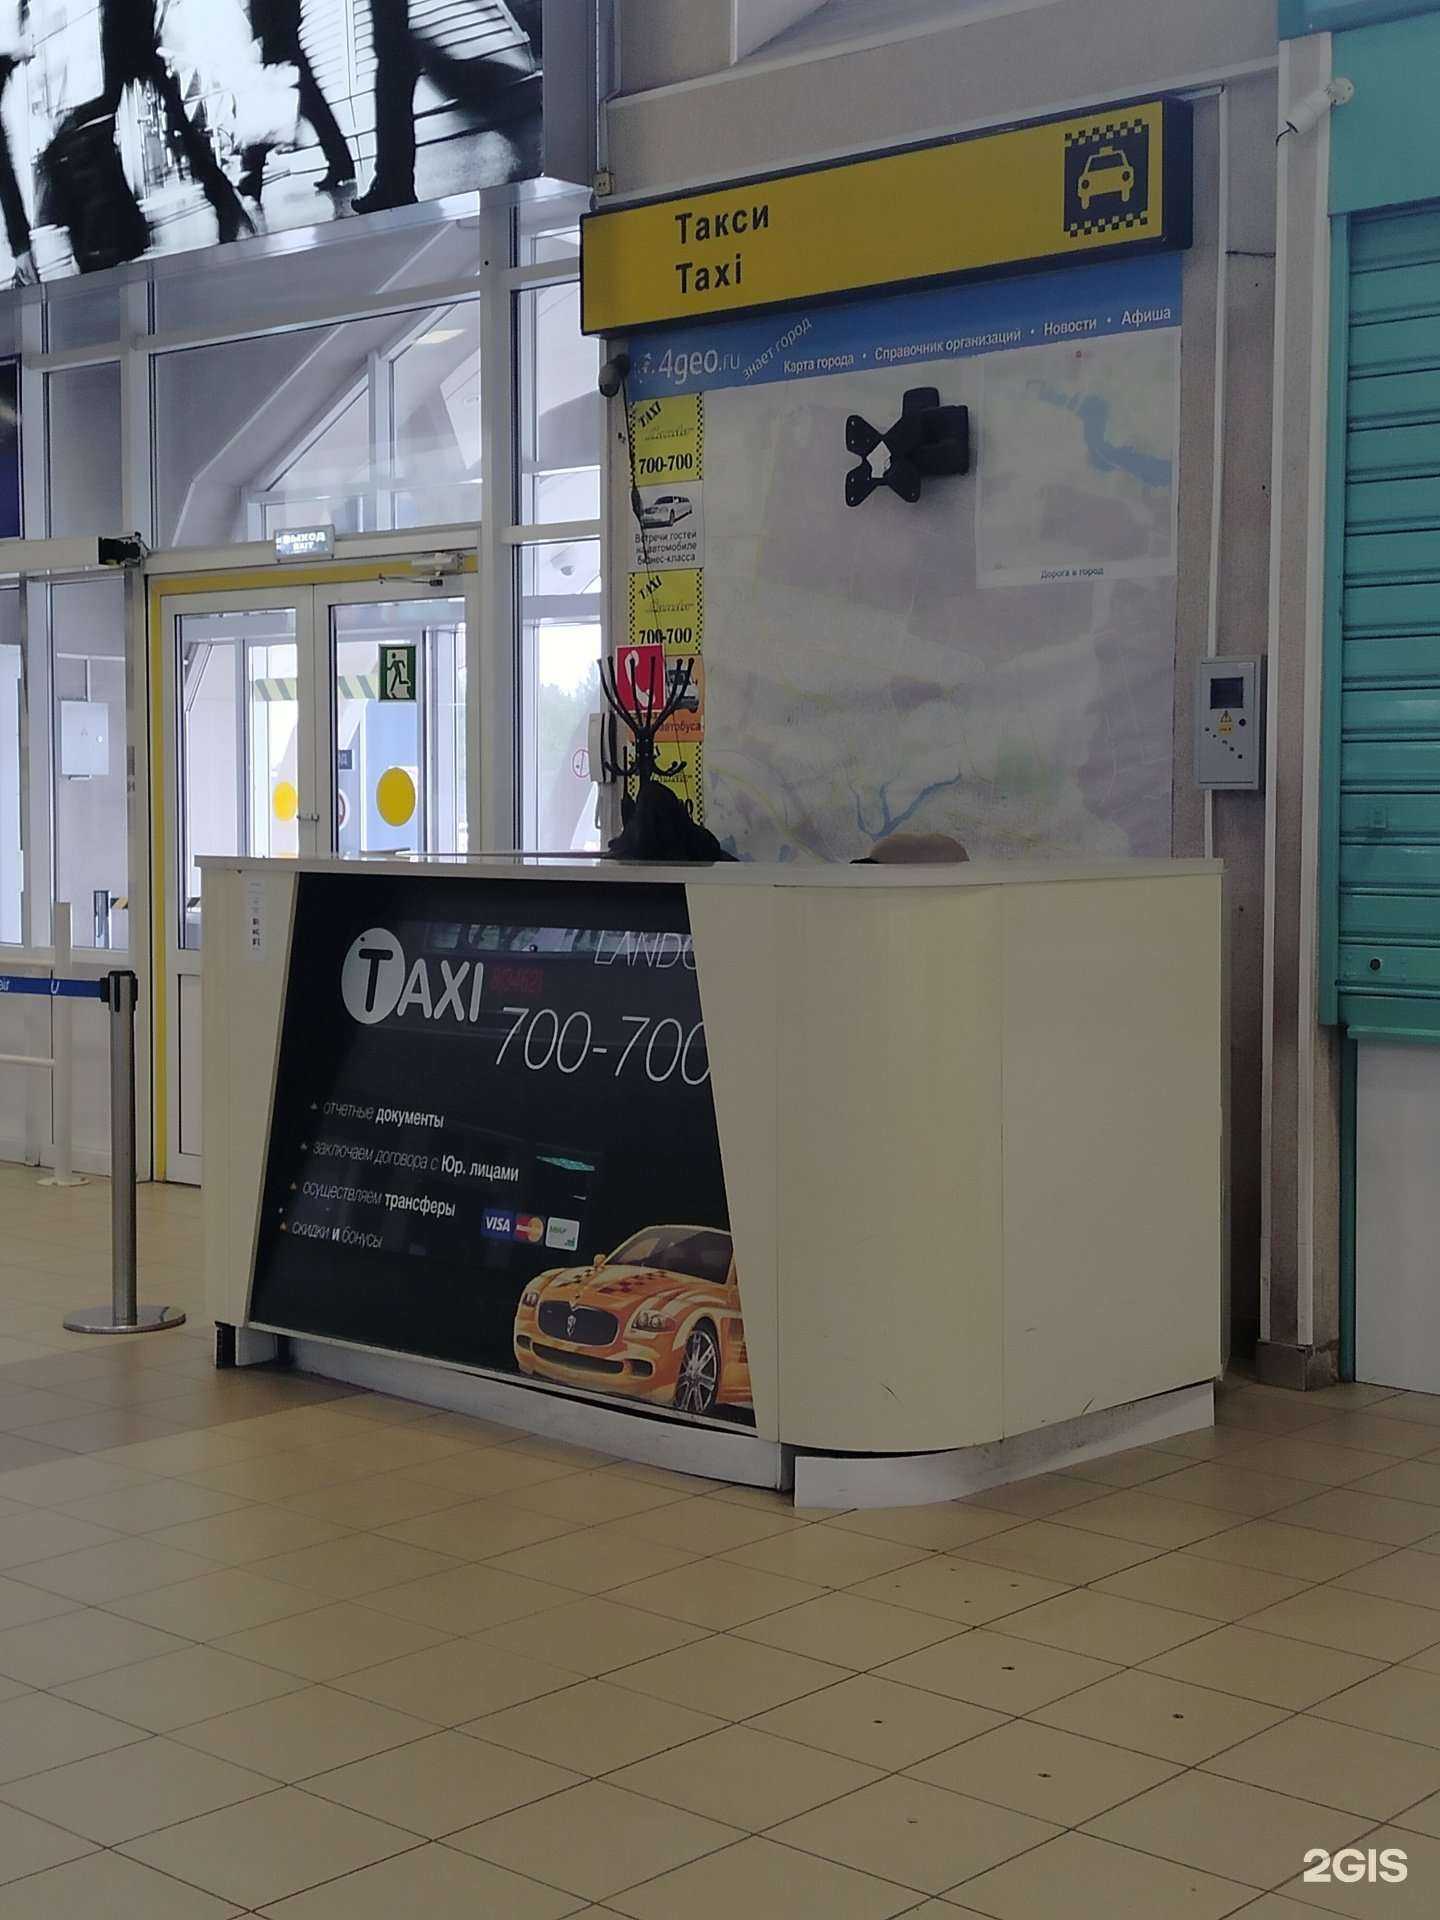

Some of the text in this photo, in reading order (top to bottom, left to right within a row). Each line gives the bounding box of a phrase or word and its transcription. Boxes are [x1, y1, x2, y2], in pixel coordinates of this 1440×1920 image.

[675, 205, 768, 244] Такси
[675, 253, 741, 293] Taxi
[742, 317, 813, 381] знает город
[784, 359, 815, 375] Карта
[817, 353, 854, 371] города
[875, 340, 943, 361] Справочник
[1044, 317, 1097, 337] Новости
[1121, 307, 1171, 328] Афиша
[659, 349, 740, 385] 4geo.ru
[638, 400, 662, 429] TAXI
[639, 453, 693, 475] 700-700
[635, 533, 668, 544] Втречи
[638, 575, 662, 601] TAXI
[1041, 567, 1071, 578] Дорога
[1079, 567, 1104, 578] город
[639, 627, 693, 645] 700-700
[356, 947, 484, 1023] TAXI
[496, 1007, 711, 1086] 700-700
[323, 1100, 445, 1129] отчетные документы
[313, 1140, 519, 1182] заключаем договора с Юр. лицами
[302, 1181, 456, 1217] осуществляем трансферы
[292, 1221, 384, 1250] скидки и бонусы
[486, 1216, 511, 1233] VISA
